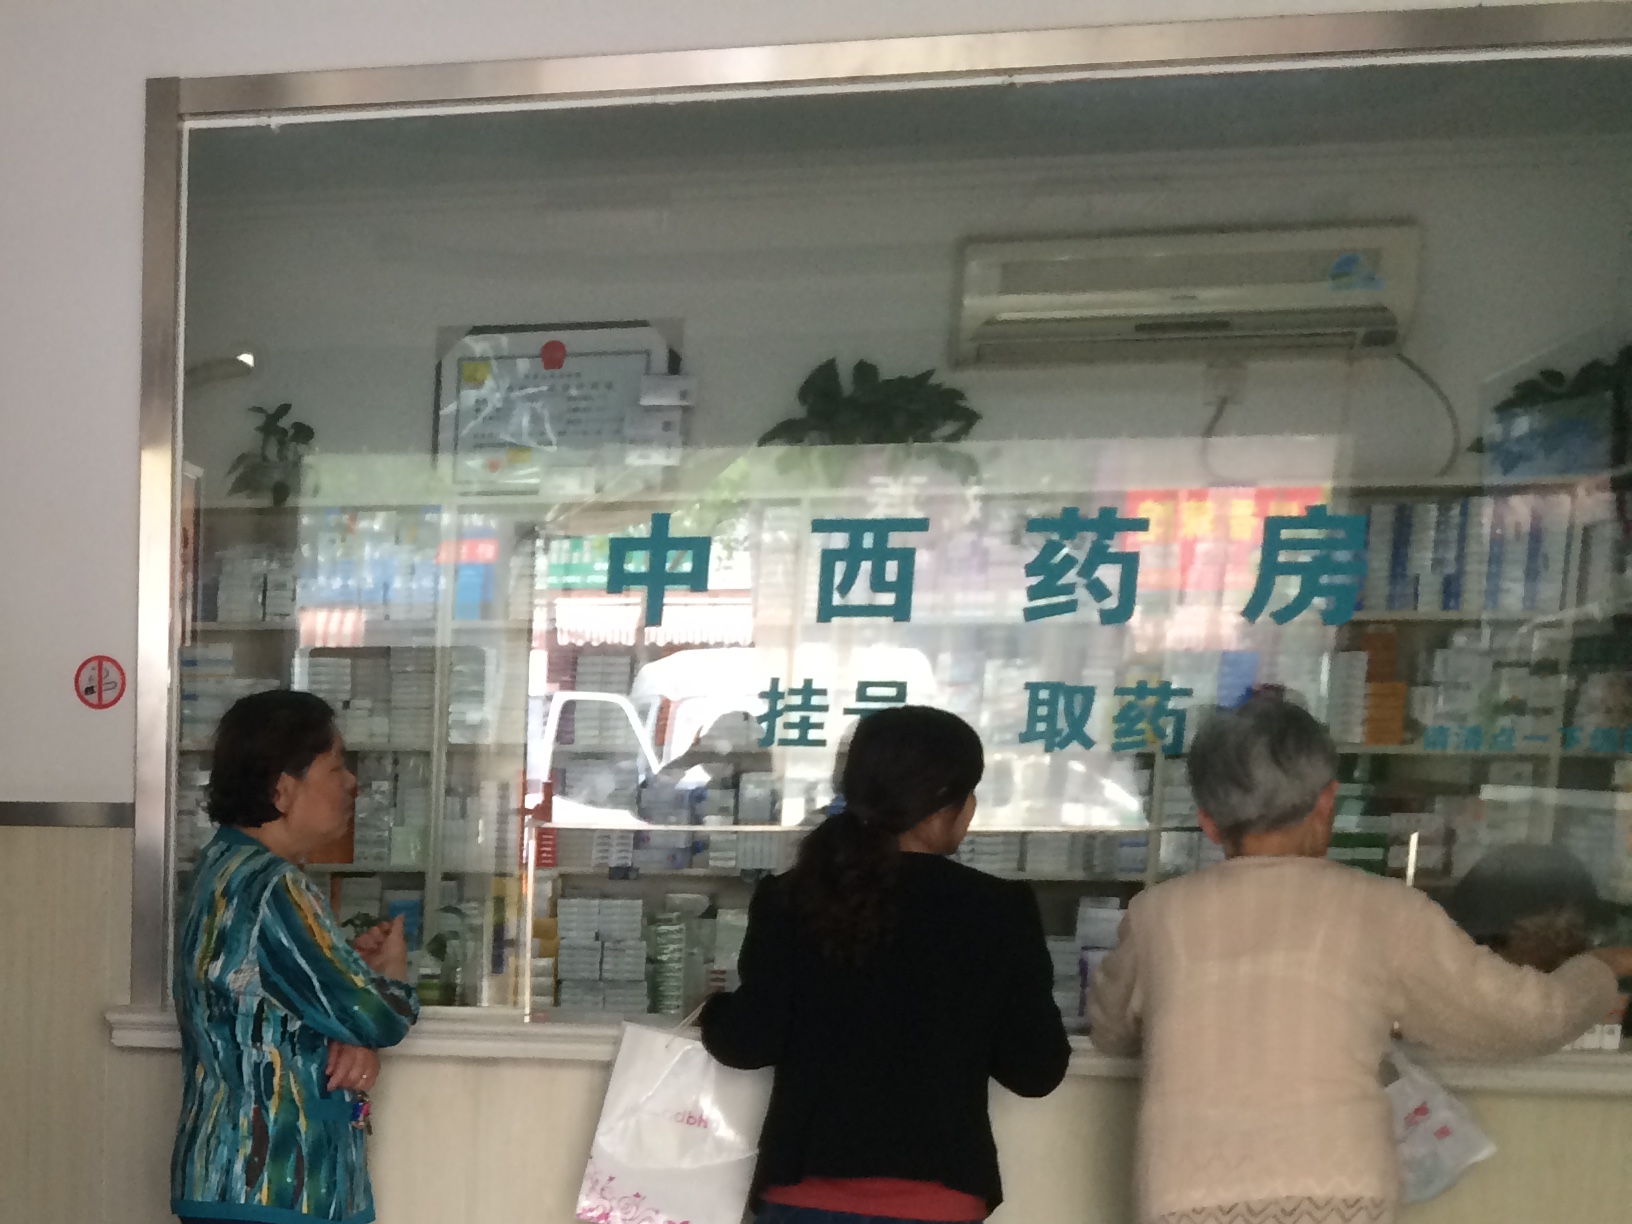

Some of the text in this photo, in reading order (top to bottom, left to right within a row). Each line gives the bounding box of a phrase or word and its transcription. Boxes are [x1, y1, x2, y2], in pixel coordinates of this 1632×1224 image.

[607, 505, 1368, 628] 中西药房
[1018, 680, 1194, 756] 取药
